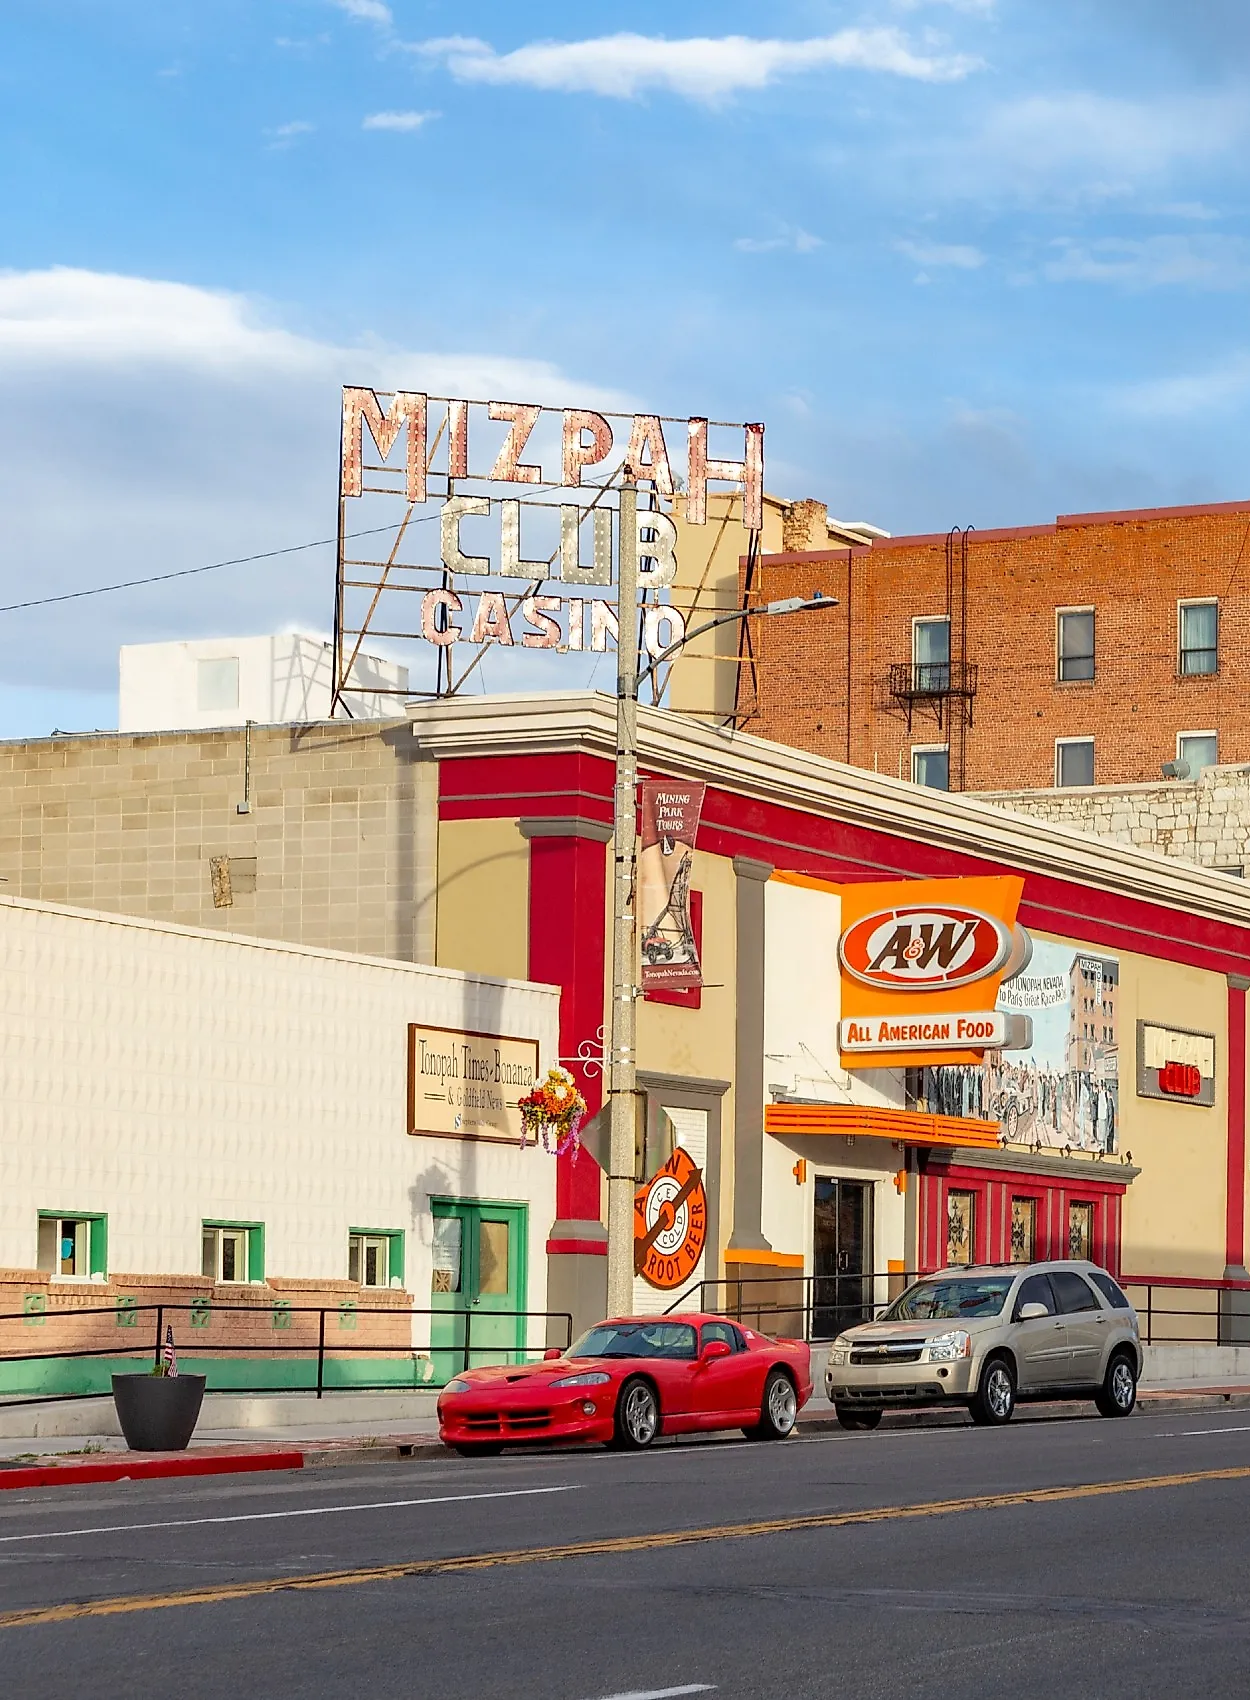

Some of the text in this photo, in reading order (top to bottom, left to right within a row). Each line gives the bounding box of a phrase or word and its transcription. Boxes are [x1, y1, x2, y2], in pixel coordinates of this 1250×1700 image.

[342, 385, 765, 530] MIZPAH
[441, 494, 678, 589] CLUB
[421, 588, 686, 662] CASINO
[655, 792, 691, 805] MINING
[658, 806, 684, 818] PARK
[656, 819, 684, 831] TOURS
[867, 921, 977, 970] A&W
[999, 988, 1006, 1001] to
[1007, 989, 1022, 1007] Paris
[1041, 992, 1055, 1007] Race
[847, 1018, 994, 1043] ALL AMERICAN FOOD
[418, 1039, 459, 1086] Tonopah
[456, 1087, 485, 1109] Goldfield
[486, 1090, 503, 1110] News
[652, 1188, 672, 1212] ICE
[647, 1202, 703, 1281] ROOT BEER
[662, 1215, 683, 1245] COLD
